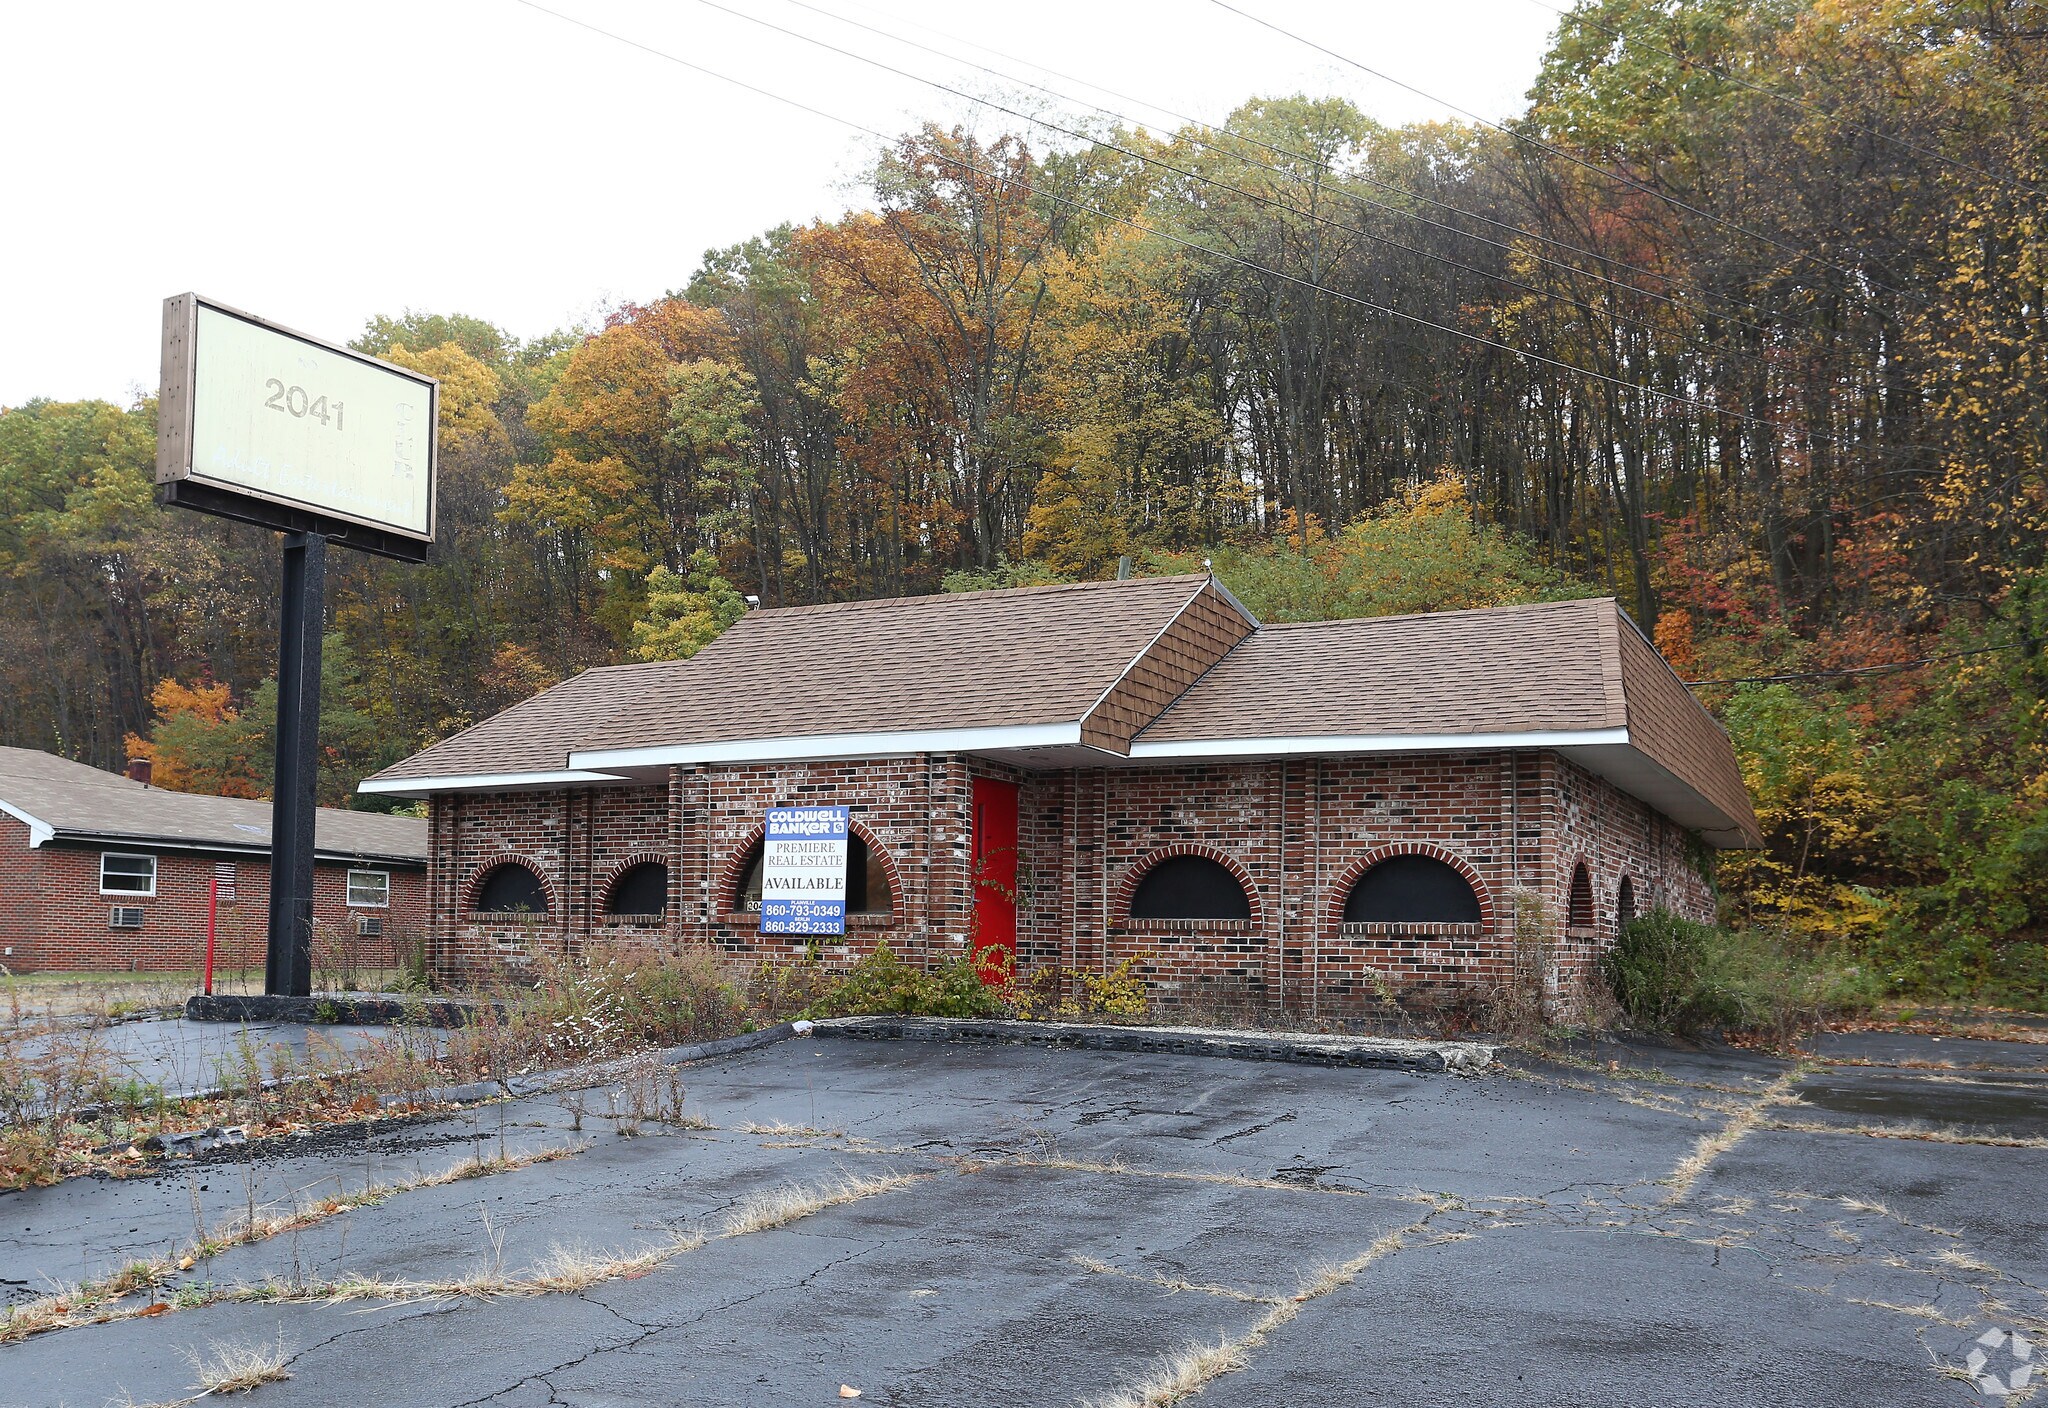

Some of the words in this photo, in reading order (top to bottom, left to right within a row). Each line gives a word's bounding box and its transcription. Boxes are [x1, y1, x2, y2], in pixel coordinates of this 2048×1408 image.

[264, 377, 344, 431] 2041
[776, 842, 836, 853] PREMIERE
[768, 855, 798, 866] REAL
[800, 855, 843, 866] ESTATE
[764, 877, 844, 890] AVAILABLE
[766, 905, 841, 917] 860-793-0349
[765, 921, 840, 933] 860-829-2333
